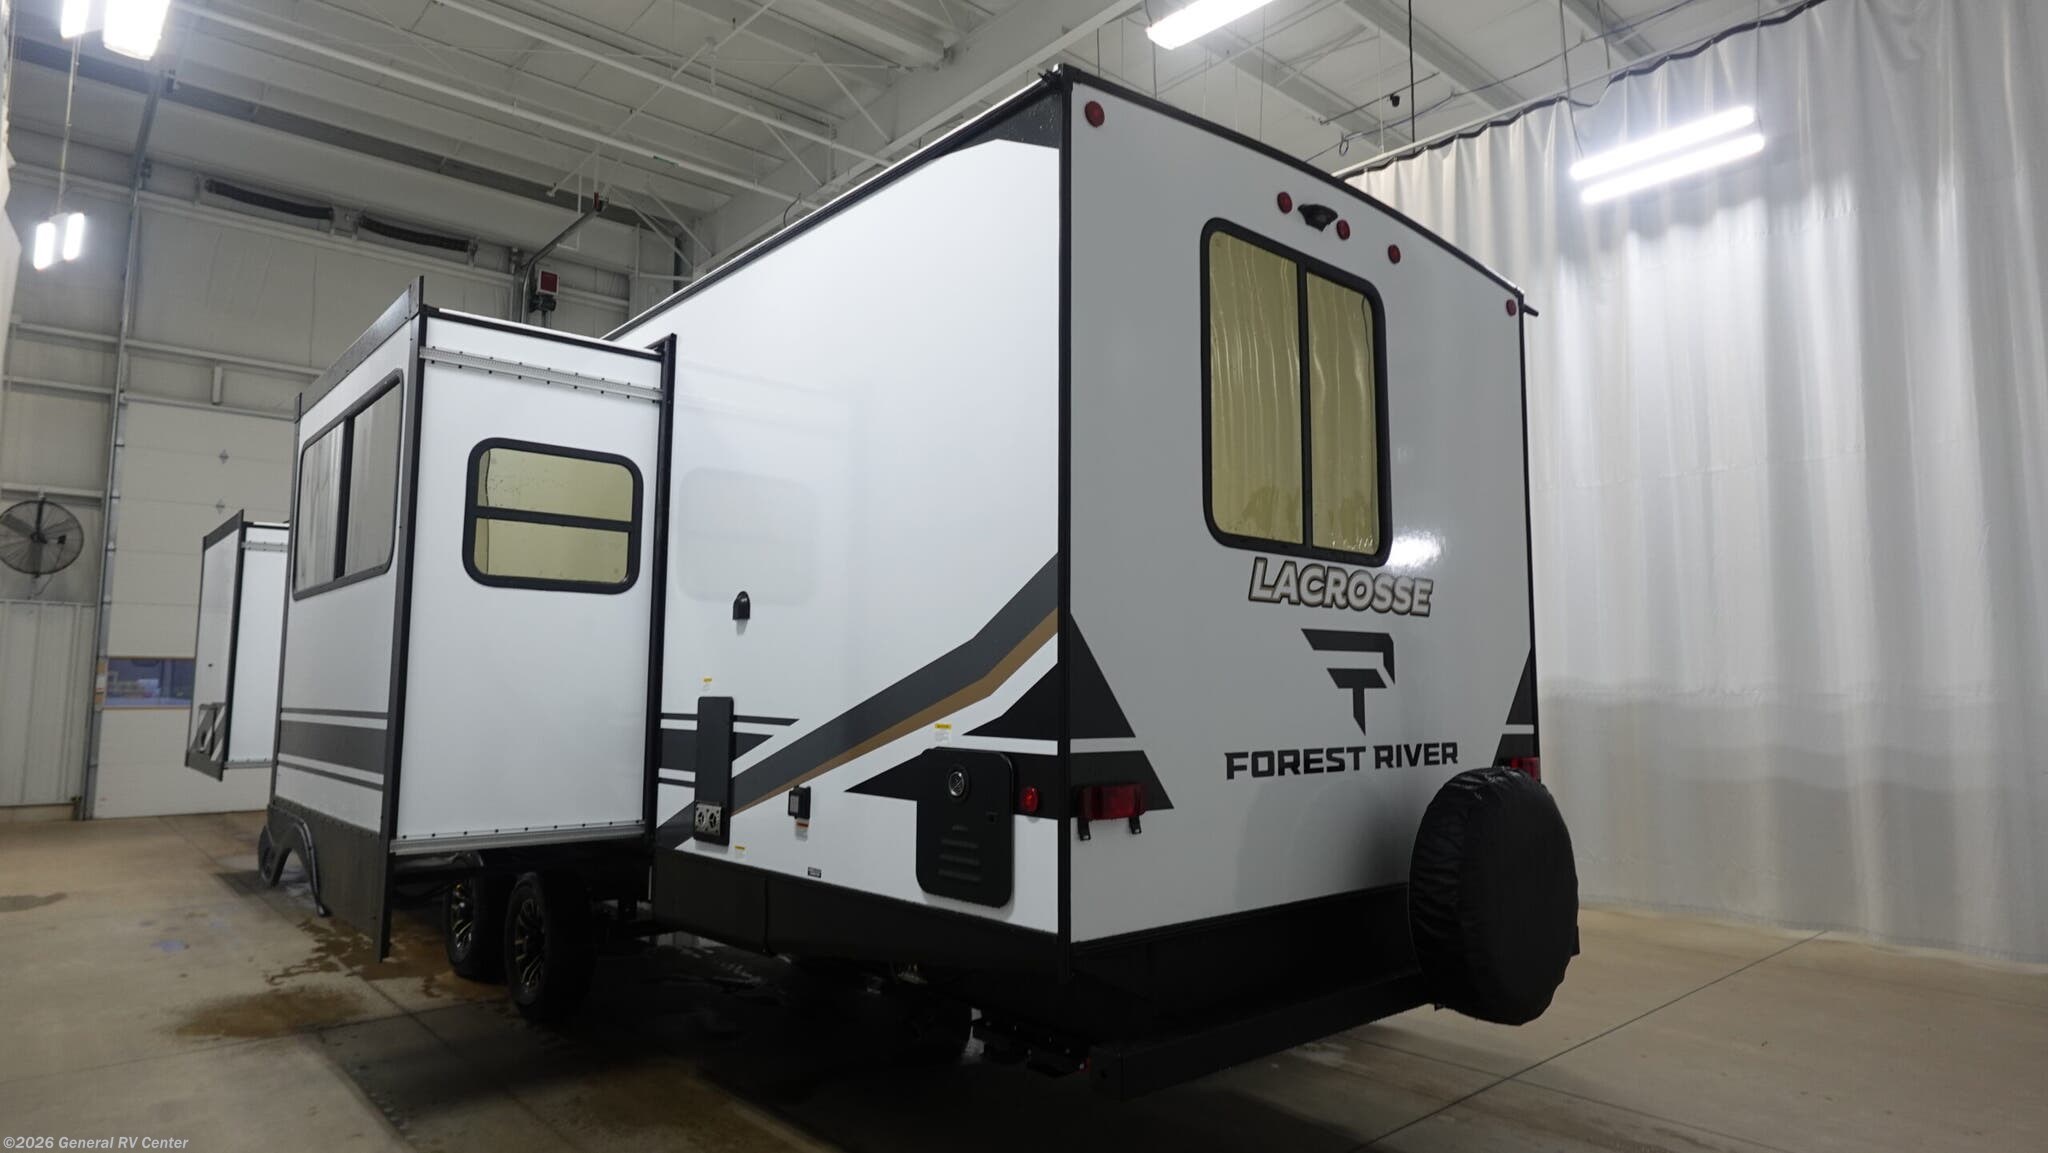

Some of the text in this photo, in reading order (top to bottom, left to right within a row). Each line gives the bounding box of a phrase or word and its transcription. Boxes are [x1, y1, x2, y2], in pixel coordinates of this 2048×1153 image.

[1249, 558, 1433, 616] LACROSSE
[1225, 742, 1458, 780] FOREST RIVER
